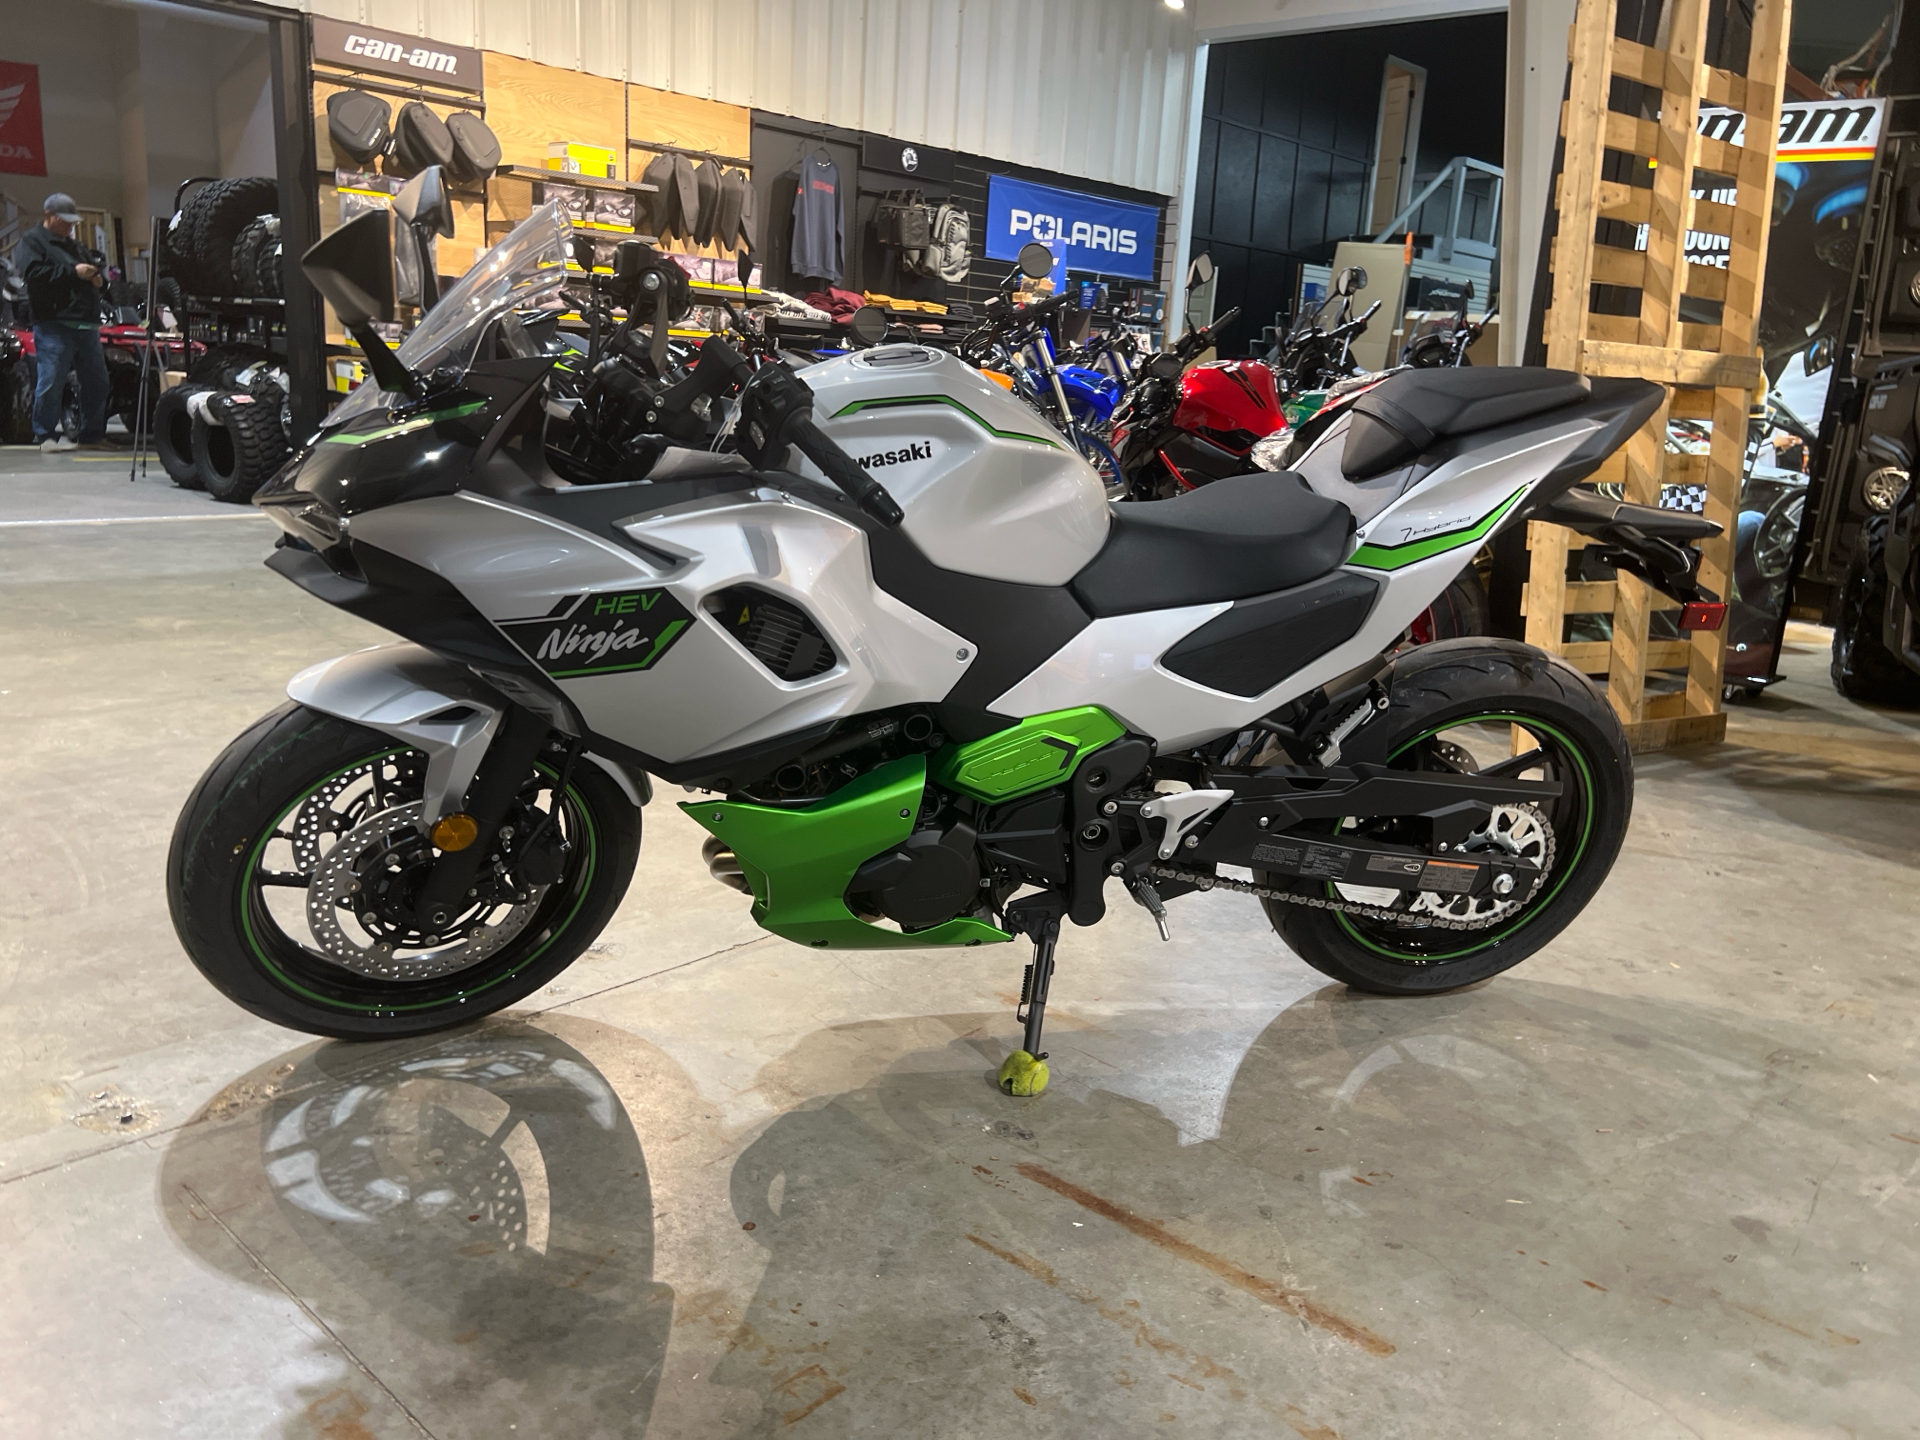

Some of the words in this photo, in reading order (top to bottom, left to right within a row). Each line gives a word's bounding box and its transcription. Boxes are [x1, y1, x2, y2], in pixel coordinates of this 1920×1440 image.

[1010, 208, 1137, 255] POLARIS
[853, 441, 932, 469] wasaki
[1400, 527, 1412, 541] 7
[594, 592, 662, 616] HEV
[536, 619, 649, 665] Ninja
